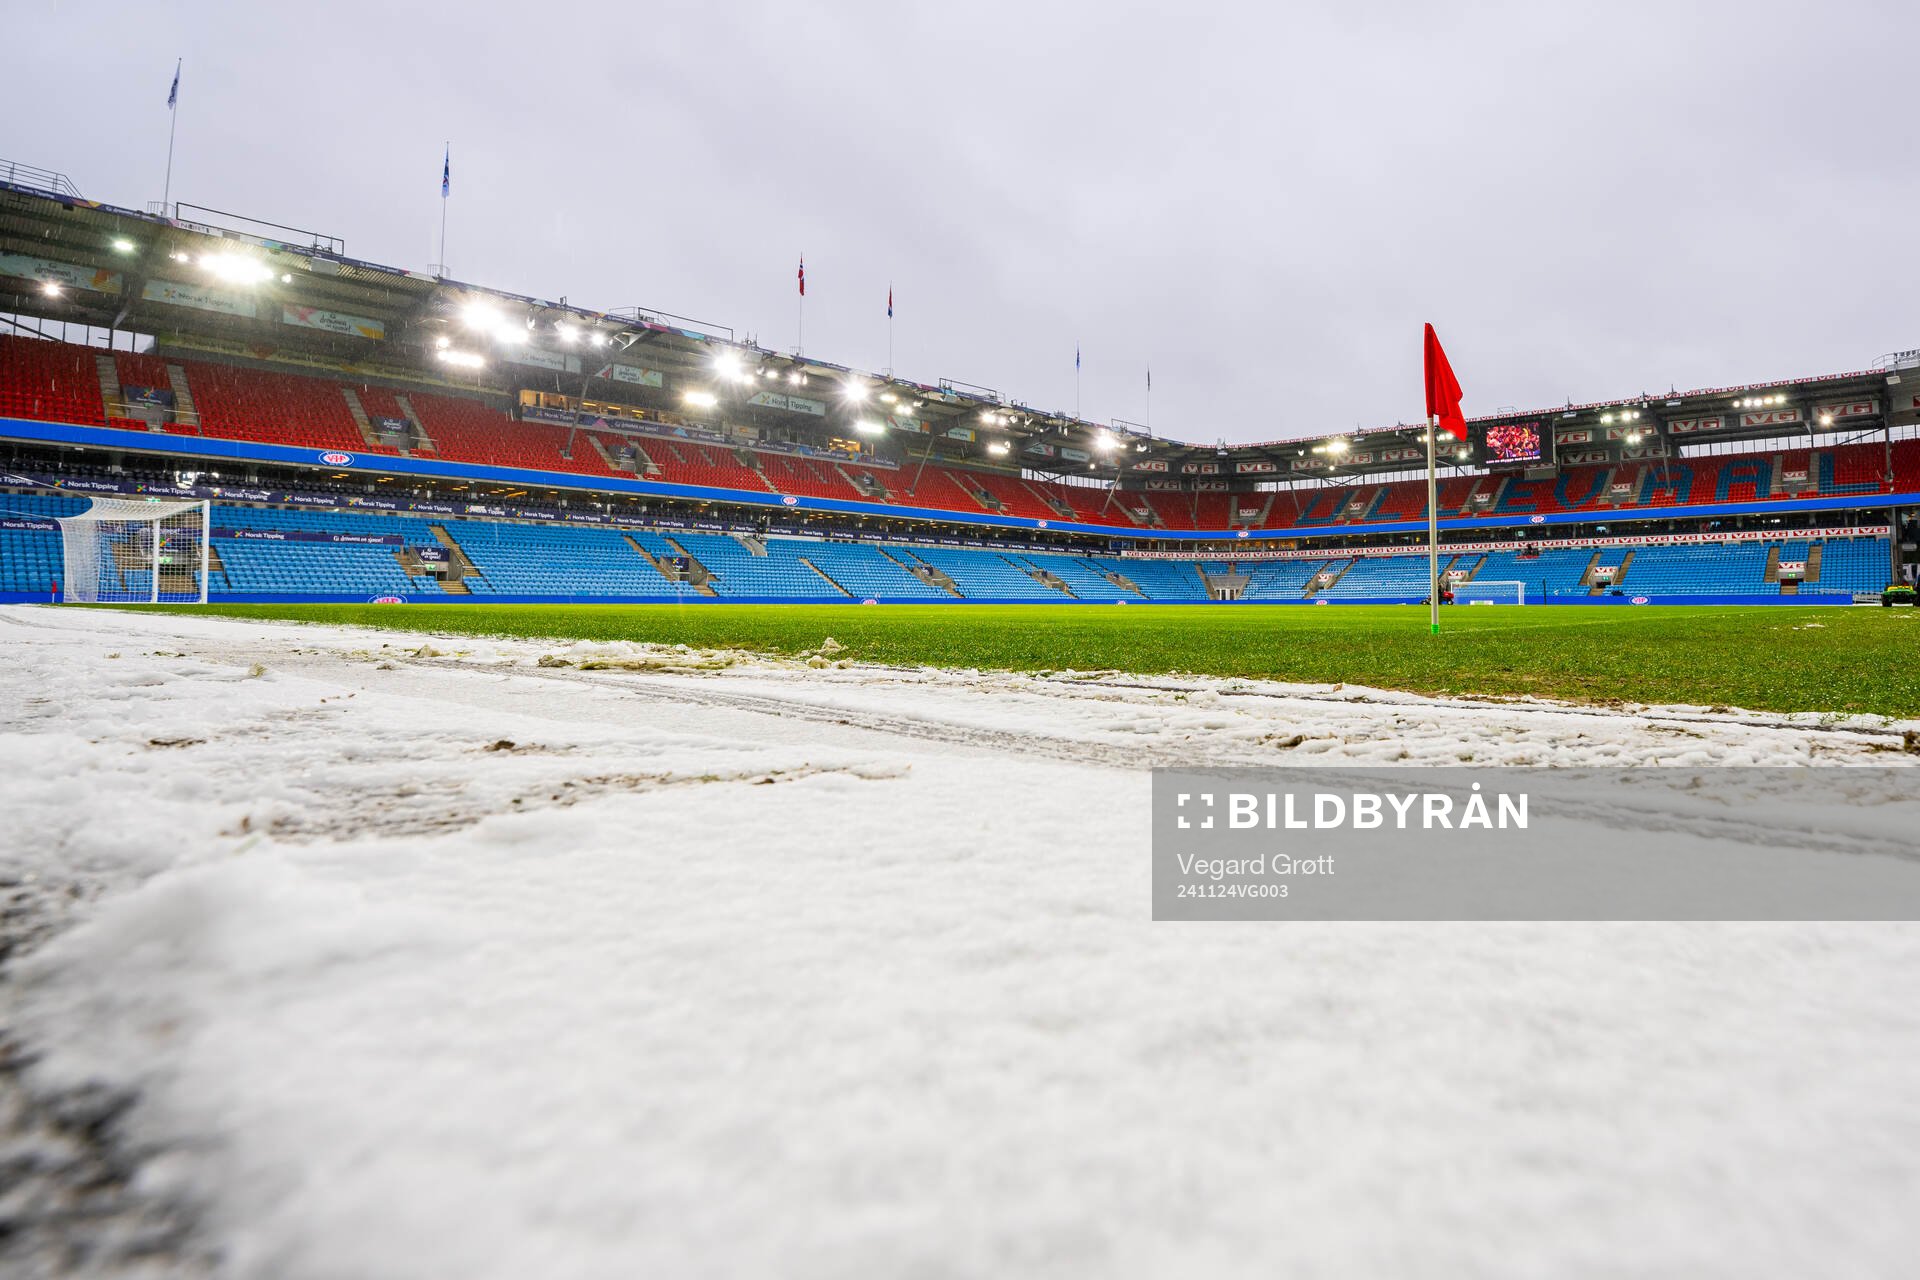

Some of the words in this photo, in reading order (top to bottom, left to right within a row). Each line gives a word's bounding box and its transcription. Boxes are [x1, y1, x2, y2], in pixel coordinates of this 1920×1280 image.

[790, 401, 812, 412] Tipping
[1818, 402, 1873, 417] VG
[1745, 410, 1797, 425] VG
[1674, 418, 1721, 432] VG
[1609, 426, 1655, 440] VG
[1566, 453, 1604, 463] VG
[1135, 462, 1166, 472] VG
[1184, 463, 1215, 473] VG
[1240, 463, 1273, 472] VG
[1294, 460, 1322, 469] VG
[3, 474, 33, 485] Tipping
[92, 483, 118, 491] Tipping
[1151, 481, 1179, 490] VG
[171, 488, 196, 496] Tipping
[26, 522, 54, 530] Tipping
